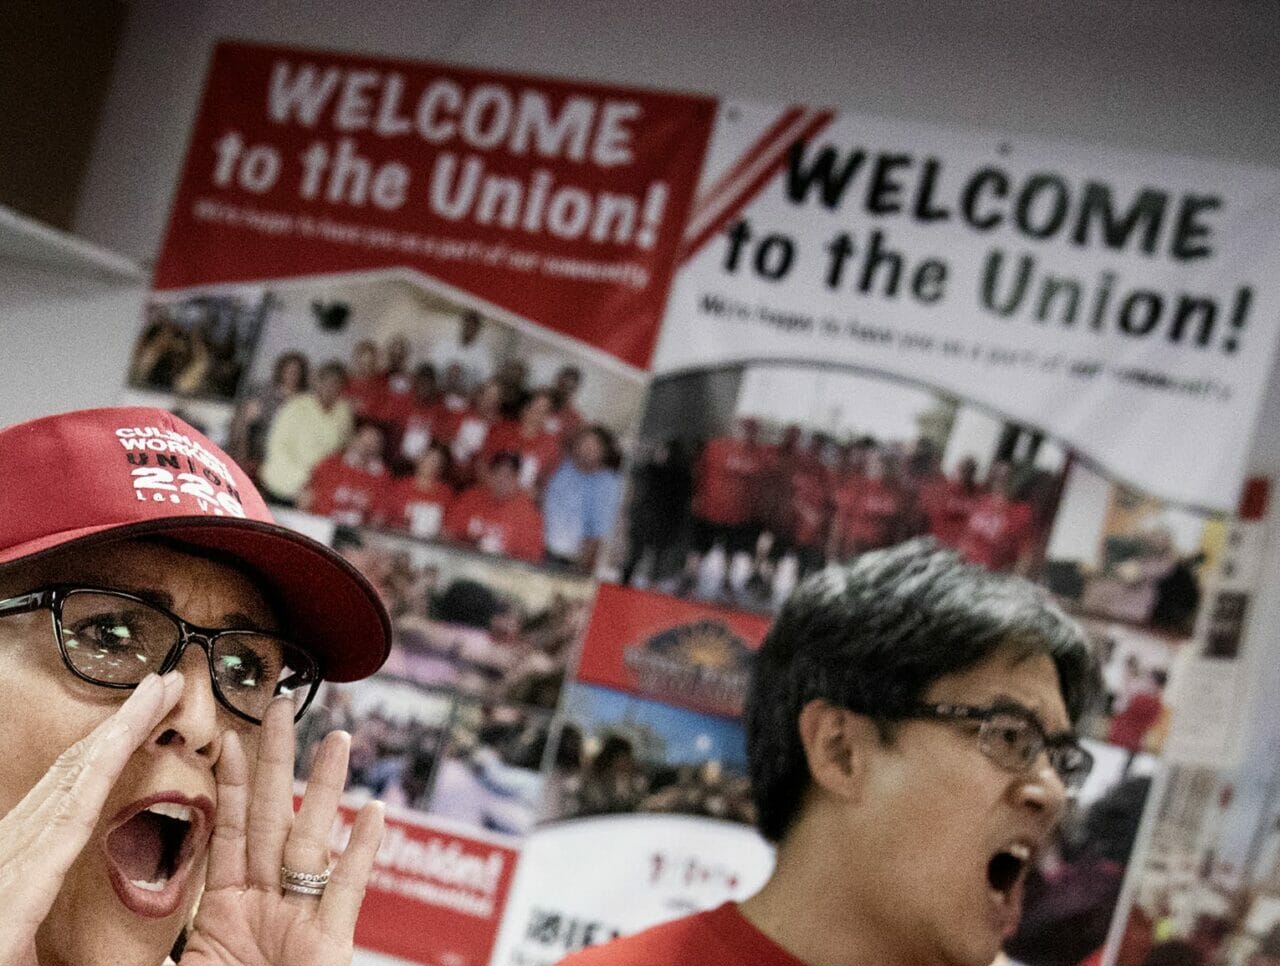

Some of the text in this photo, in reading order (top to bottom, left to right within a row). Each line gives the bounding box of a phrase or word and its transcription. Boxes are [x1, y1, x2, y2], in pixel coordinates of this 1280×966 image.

[267, 60, 644, 168] WELCOME
[211, 130, 672, 252] to the Union!
[782, 138, 1222, 262] WELCOME
[721, 215, 1255, 356] to the Union!
[126, 452, 242, 505] UNION
